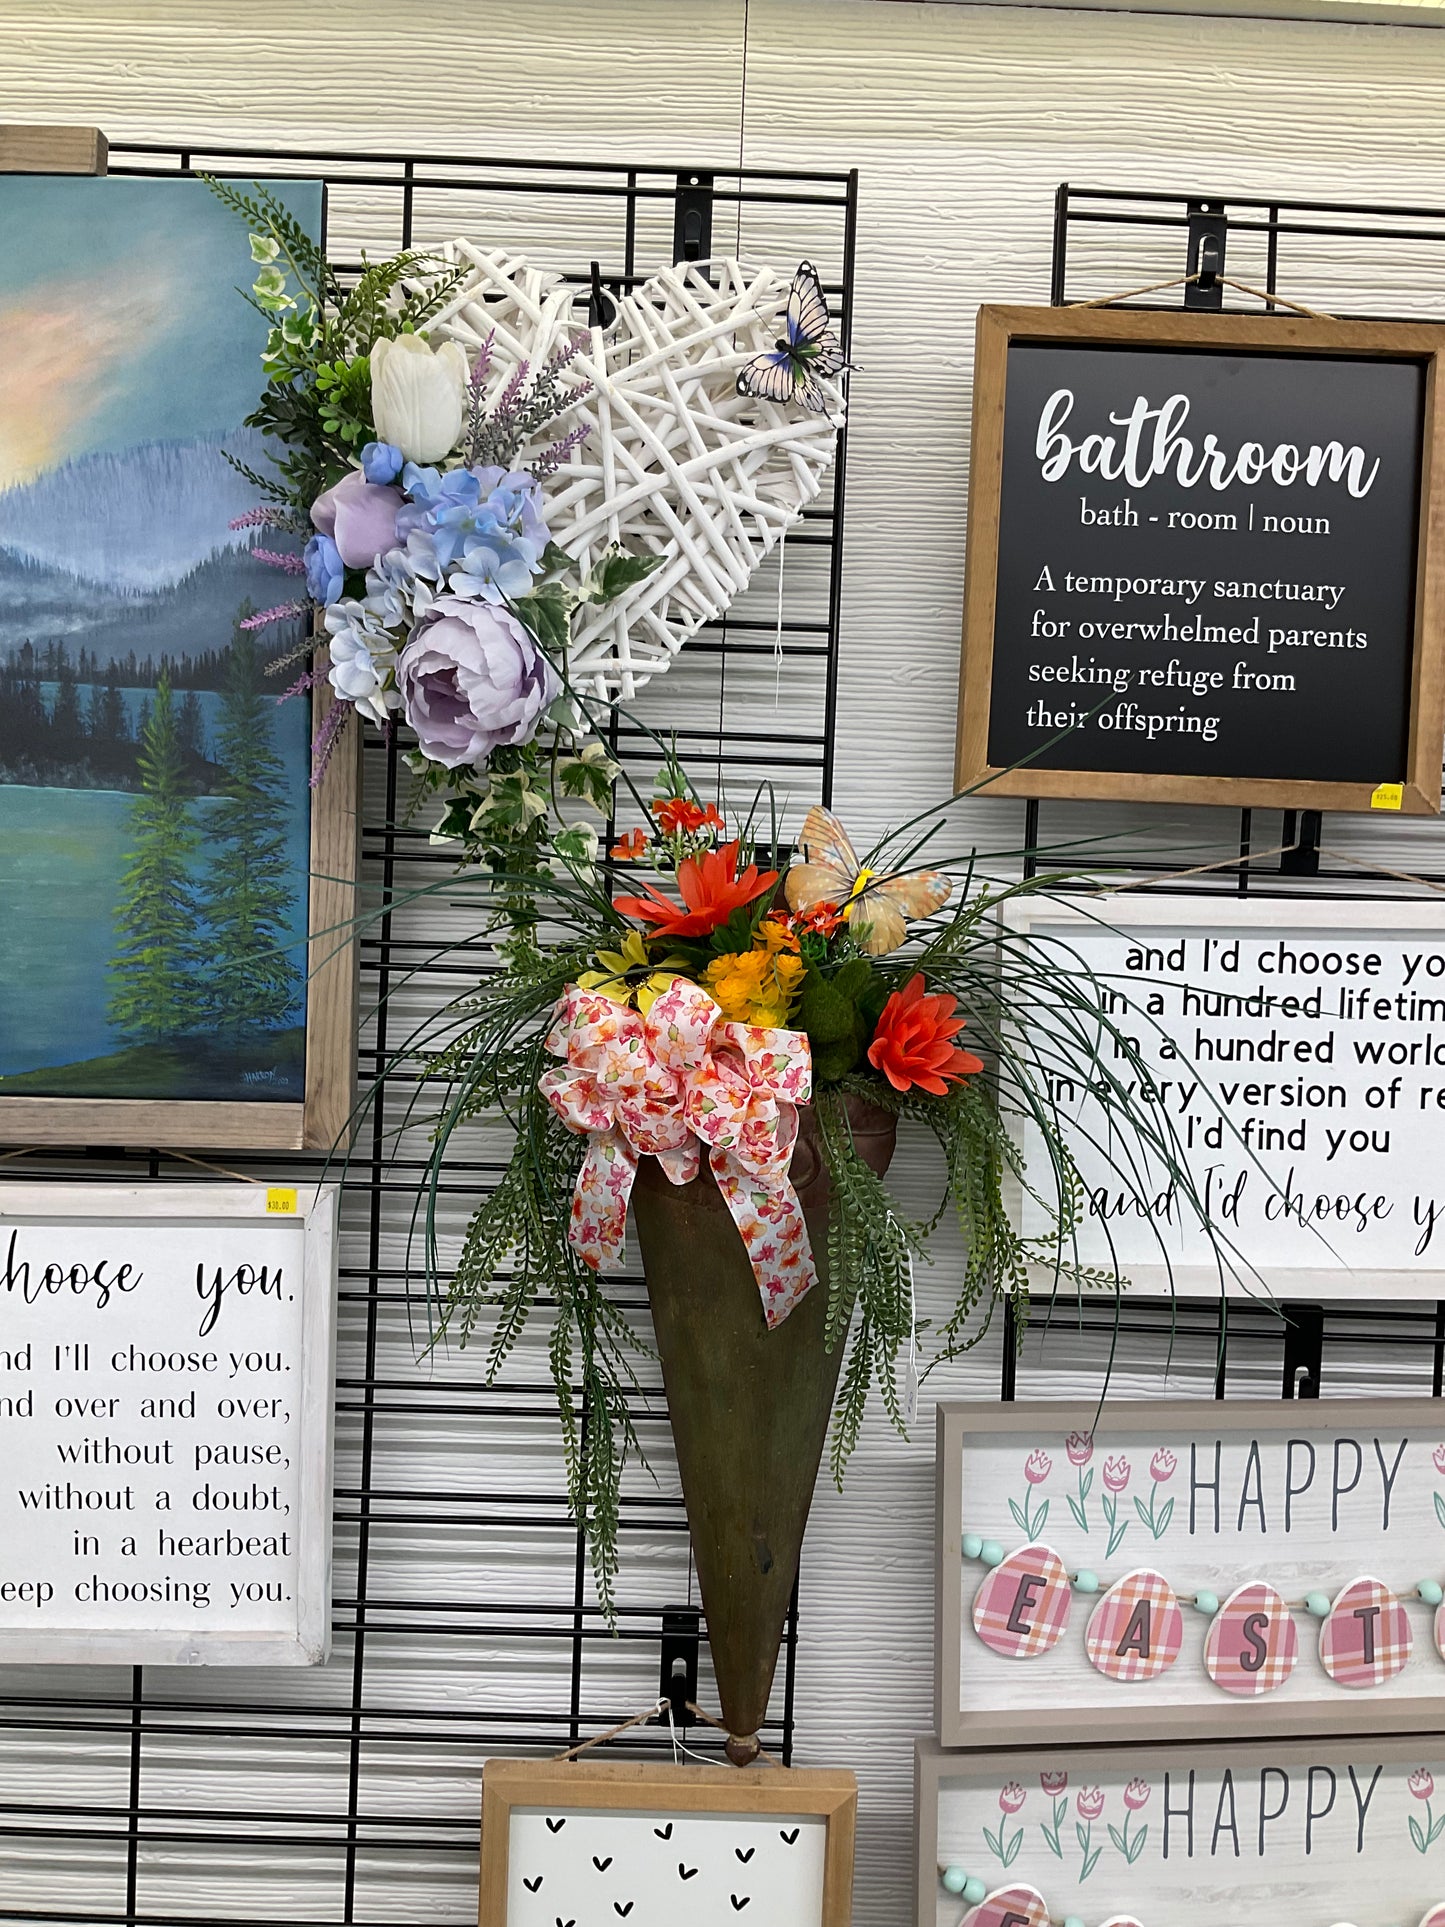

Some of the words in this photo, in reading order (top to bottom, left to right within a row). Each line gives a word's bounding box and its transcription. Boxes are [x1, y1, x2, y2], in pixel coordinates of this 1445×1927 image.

[1036, 388, 1380, 498] bathroom
[1079, 496, 1139, 527] bath
[1167, 511, 1238, 531] room
[1262, 516, 1331, 535] noun
[1032, 565, 1057, 592] A
[1064, 571, 1207, 605] temporary
[1213, 579, 1346, 610] sanctuary
[1030, 609, 1071, 638] for
[1078, 613, 1260, 644] overwhelmed
[1267, 628, 1368, 654] parents
[1028, 655, 1131, 693] seeking
[1138, 658, 1224, 696] refuge
[1231, 661, 1296, 691] from
[1026, 701, 1089, 729] their
[1098, 702, 1221, 742] offspring
[1125, 940, 1186, 972] and
[1203, 938, 1240, 973] I'd
[1257, 941, 1382, 976] choose
[1146, 992, 1165, 1016] a
[1182, 983, 1321, 1019] hundred
[1159, 1038, 1176, 1059] a
[1195, 1027, 1334, 1064] hundred
[1048, 1072, 1074, 1102] in
[1219, 1078, 1346, 1107] version
[1365, 1076, 1403, 1109] of
[1188, 1115, 1223, 1149] I'd
[1242, 1118, 1305, 1151] find
[1325, 1129, 1390, 1162] you
[268, 1201, 289, 1210] $30.00
[1090, 1186, 1178, 1225] and
[1265, 1166, 1394, 1232] choose
[196, 1262, 294, 1338] you.
[55, 1343, 89, 1371] I'll
[111, 1344, 218, 1372] choose
[229, 1352, 291, 1379] you.
[55, 1398, 120, 1418] over
[140, 1390, 195, 1419] and
[217, 1399, 290, 1424] over,
[57, 1436, 173, 1465] without
[195, 1445, 290, 1471] pause,
[18, 1482, 134, 1511] without
[155, 1491, 171, 1511] a
[192, 1483, 290, 1516] doubt,
[1189, 1438, 1408, 1535] HAPPY
[74, 1529, 99, 1556] in
[121, 1536, 137, 1556] a
[159, 1528, 292, 1557] hearbeat
[0, 1582, 54, 1608] eep
[74, 1574, 211, 1609] choosing
[230, 1582, 292, 1609] you.
[1163, 1765, 1383, 1859] HAPPY
